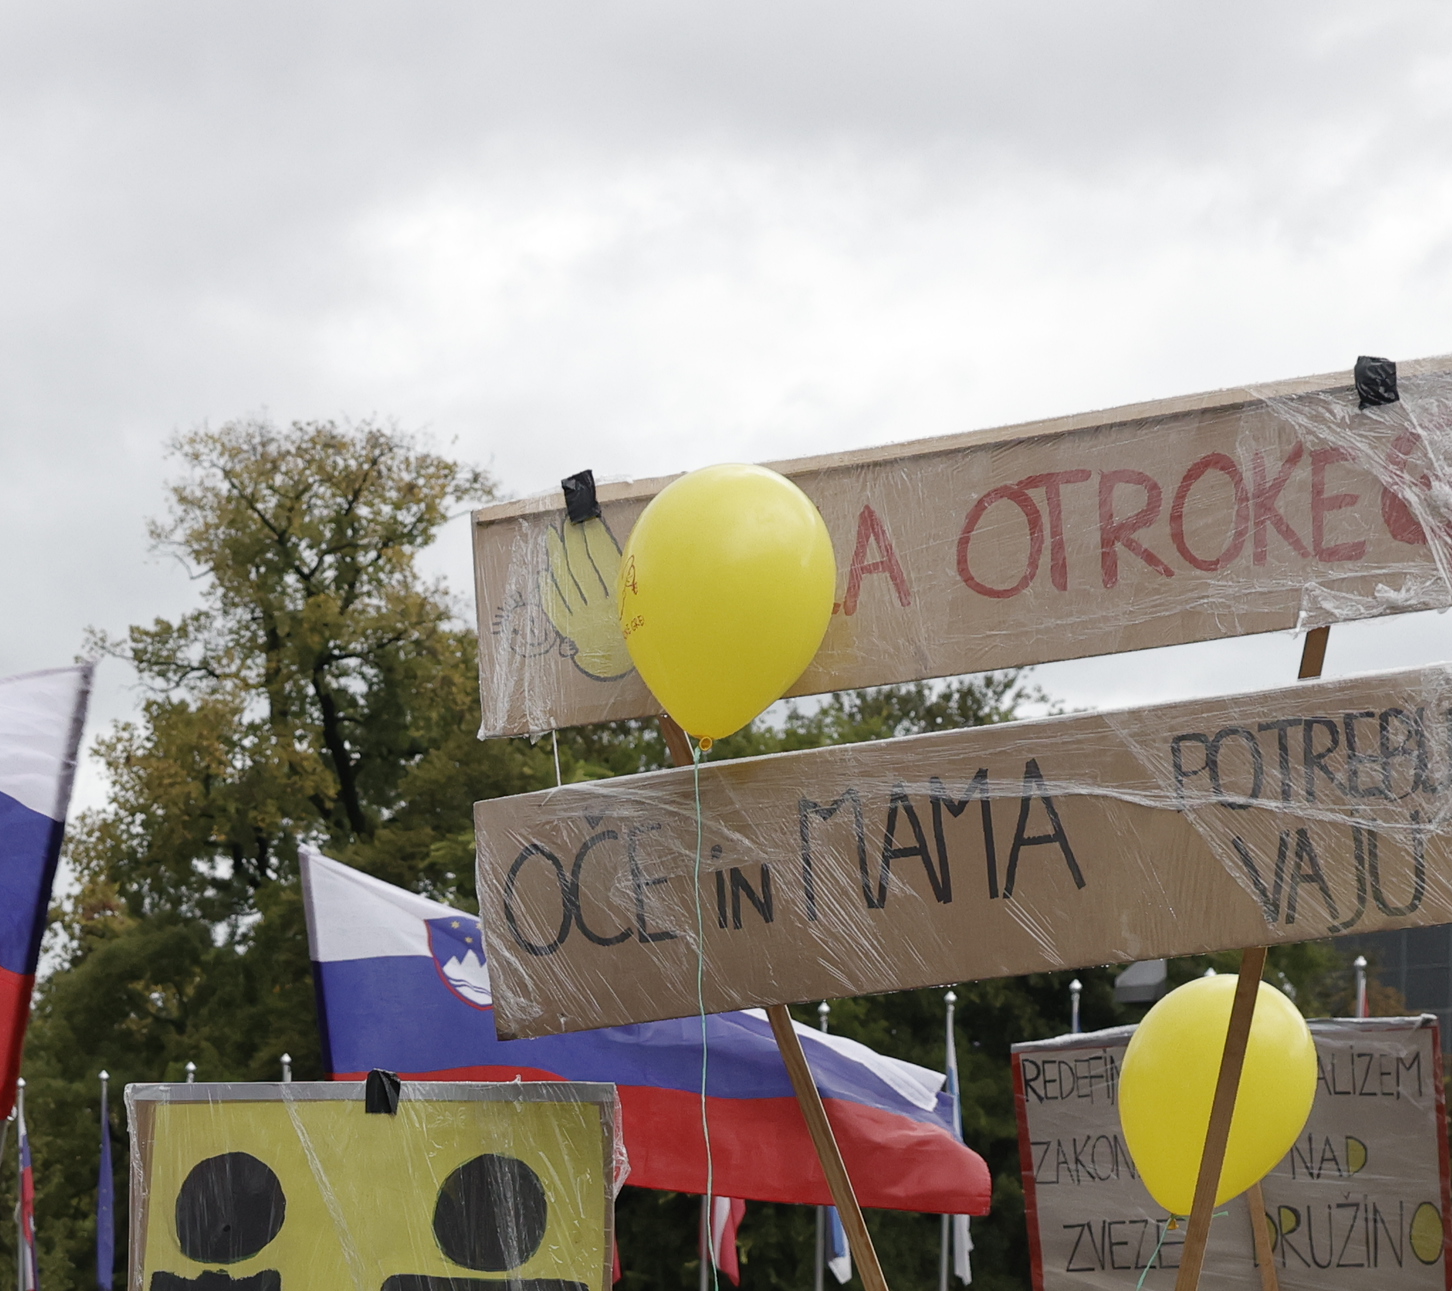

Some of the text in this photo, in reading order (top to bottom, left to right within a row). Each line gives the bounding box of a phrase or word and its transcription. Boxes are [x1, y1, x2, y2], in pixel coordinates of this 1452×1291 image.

[832, 440, 1366, 616] A OTROKE
[504, 812, 680, 957] OČE
[799, 758, 1086, 921] MAMA
[1232, 810, 1426, 934] VAJU
[1031, 1134, 1140, 1186] ZAKON
[1291, 1133, 1367, 1180] NAD
[1063, 1219, 1186, 1273] ZVEZE
[1253, 1191, 1444, 1269] DRUŽINO
